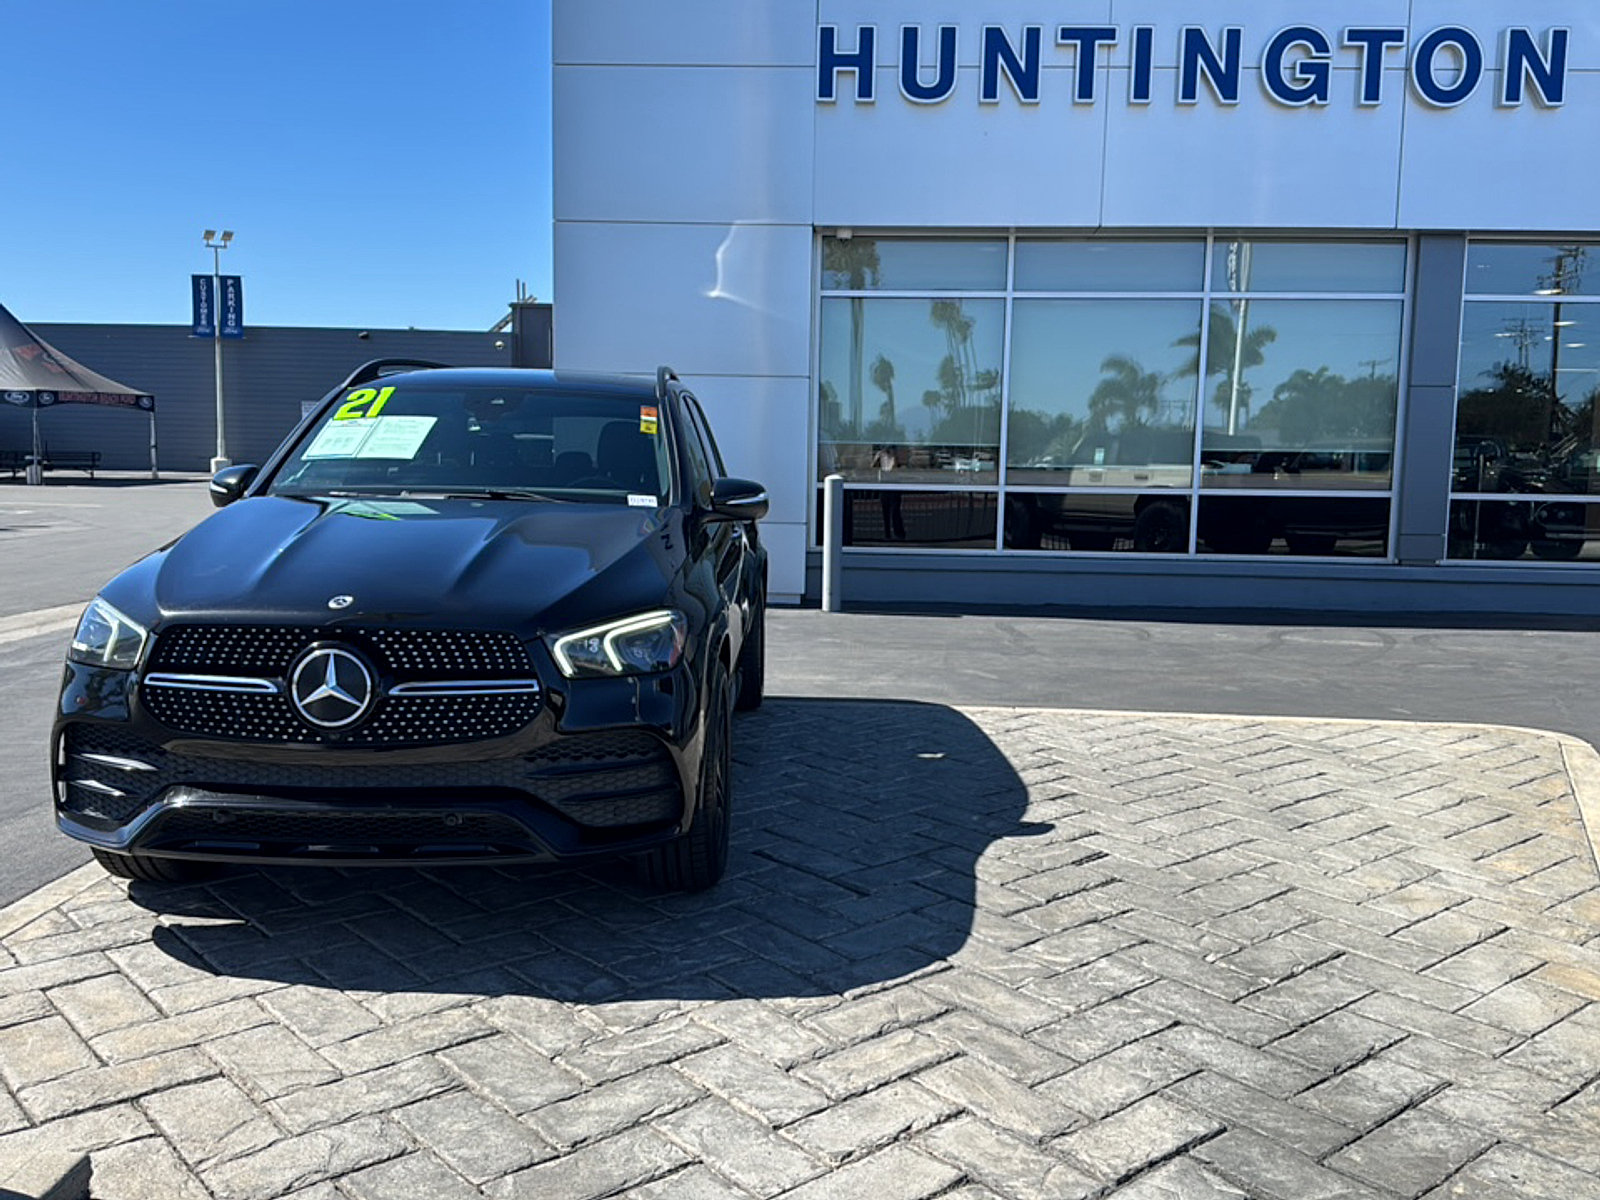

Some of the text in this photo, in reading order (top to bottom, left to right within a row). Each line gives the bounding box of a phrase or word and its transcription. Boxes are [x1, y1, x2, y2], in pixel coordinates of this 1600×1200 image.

[817, 25, 1570, 107] HUNTINGTON
[226, 278, 236, 327] PARKING
[334, 386, 397, 420] 21
